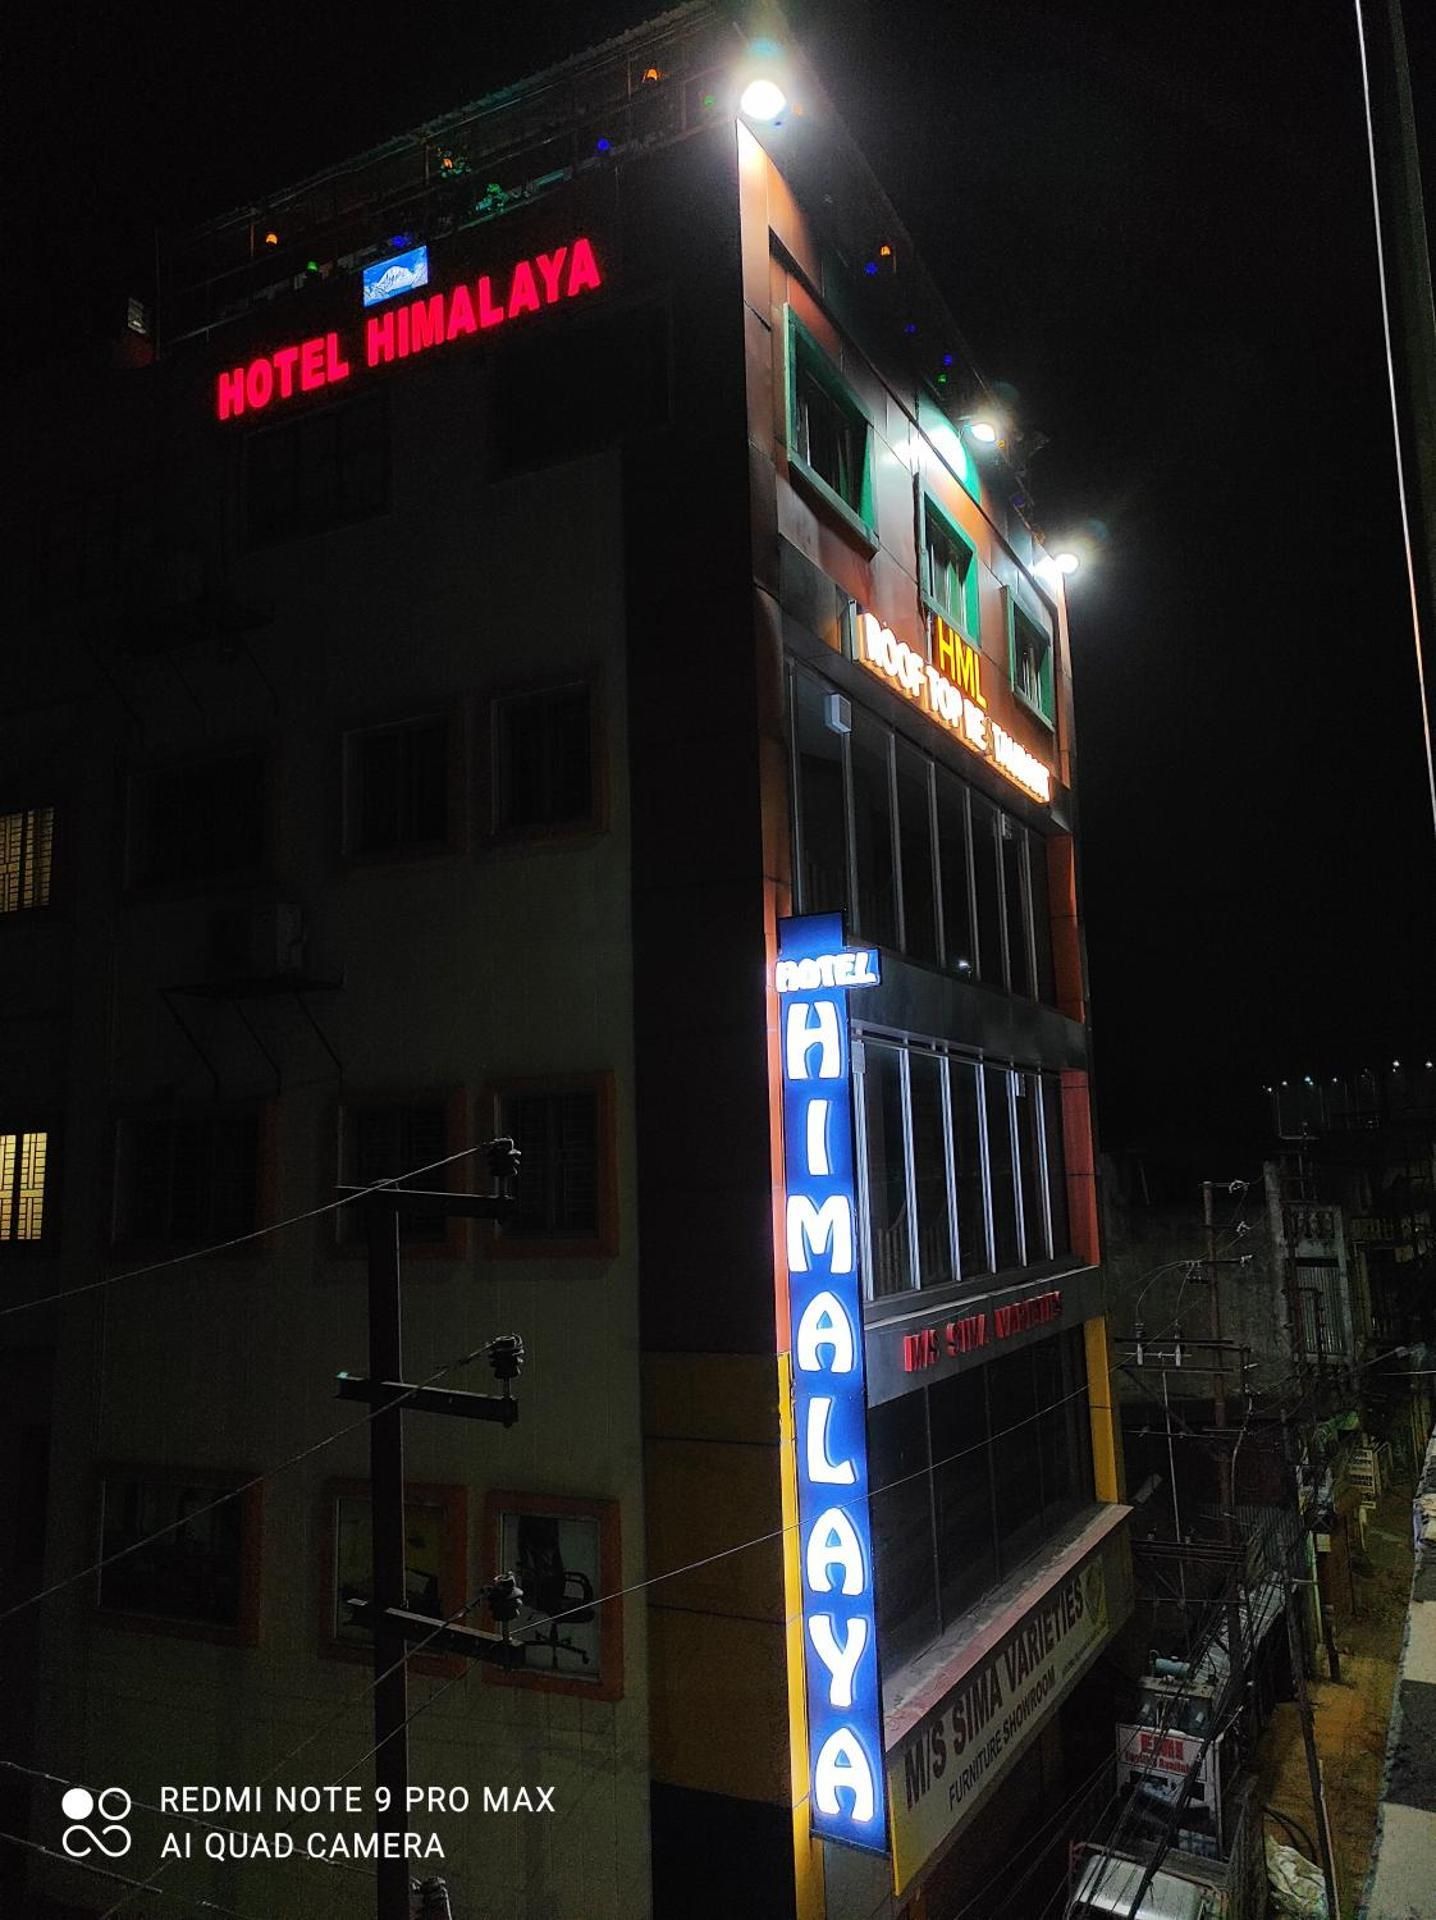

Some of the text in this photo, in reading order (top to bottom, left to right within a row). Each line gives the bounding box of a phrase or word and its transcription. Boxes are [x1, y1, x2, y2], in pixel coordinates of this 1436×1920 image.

[218, 238, 601, 421] HOTEL HIMALAYA
[937, 617, 989, 710] HML
[776, 951, 877, 992] HOTEL
[786, 1001, 876, 1822] HIMALAYA
[904, 1577, 1084, 1812] M/S SIMA VARIETIES
[949, 1664, 1056, 1811] FURNITURE SHOWROOM
